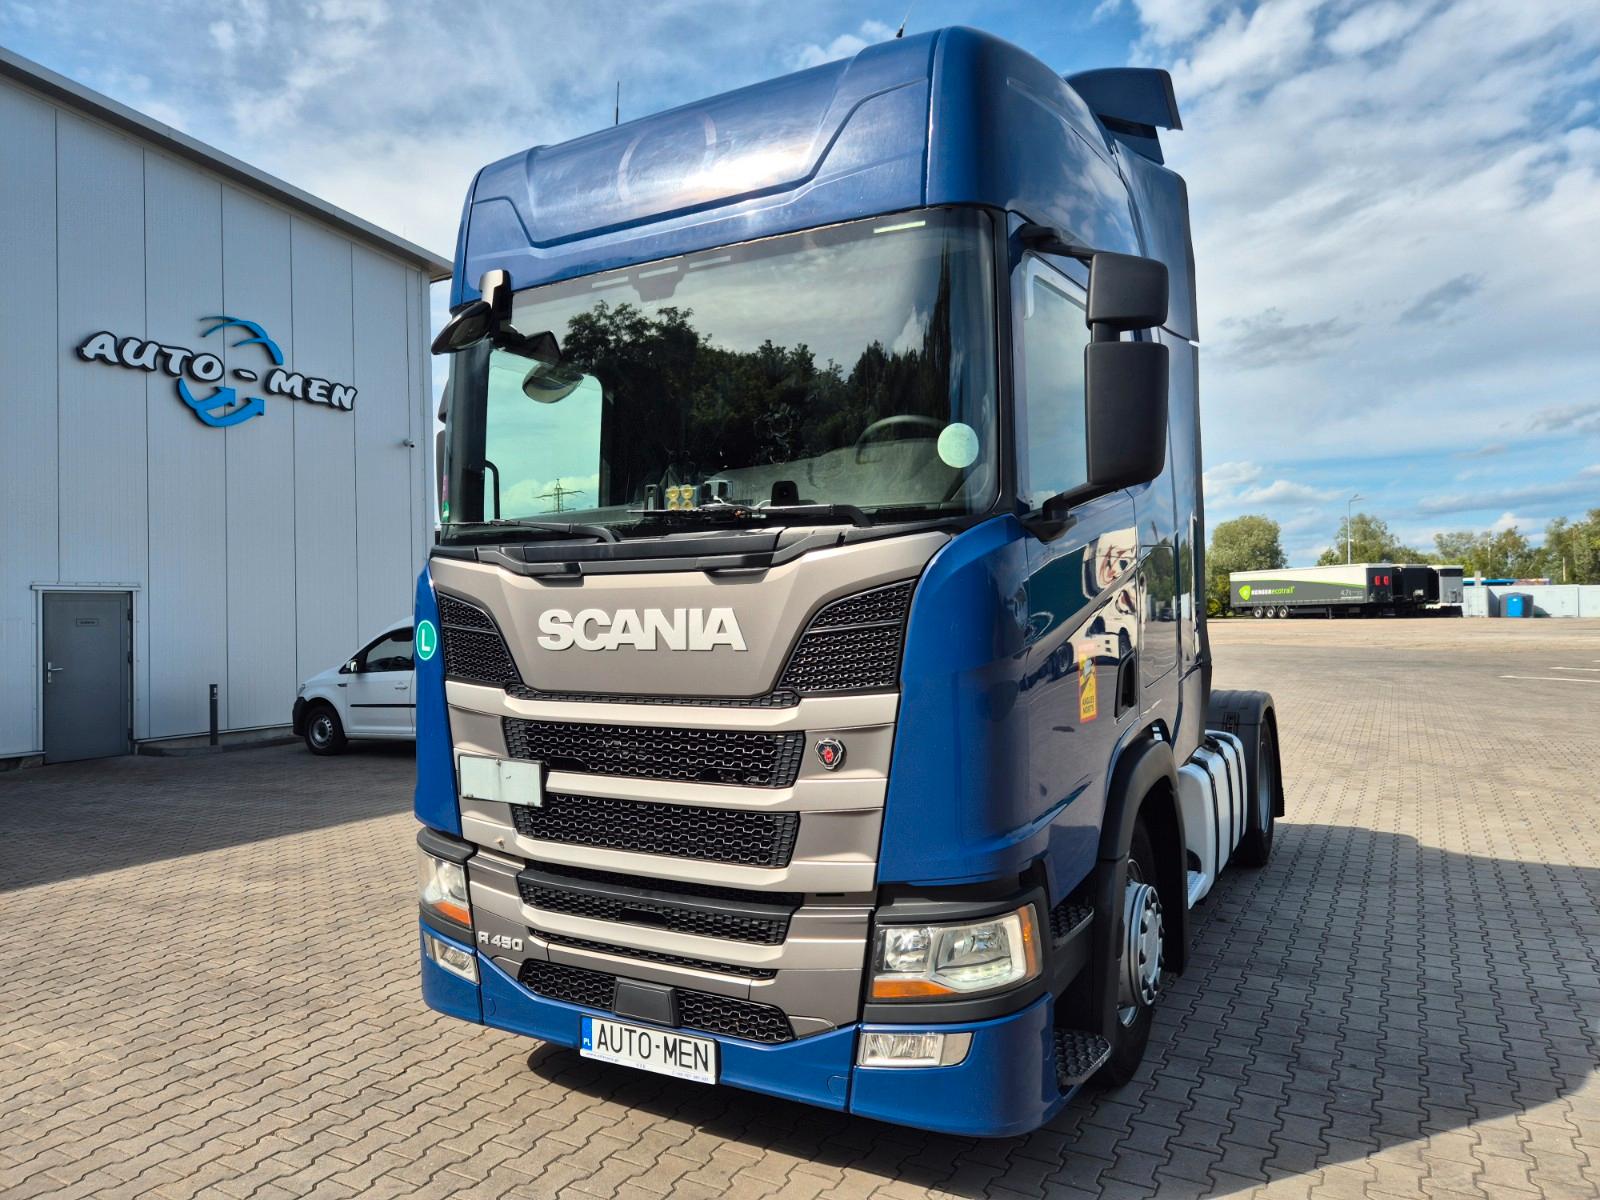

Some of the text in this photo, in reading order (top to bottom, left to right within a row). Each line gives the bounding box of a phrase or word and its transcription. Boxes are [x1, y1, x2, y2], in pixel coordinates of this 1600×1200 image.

[421, 628, 431, 651] L
[536, 607, 748, 651] SCANIA
[478, 931, 524, 952] R 450
[583, 1038, 591, 1046] PL
[597, 1023, 709, 1072] AUTO-MEN
